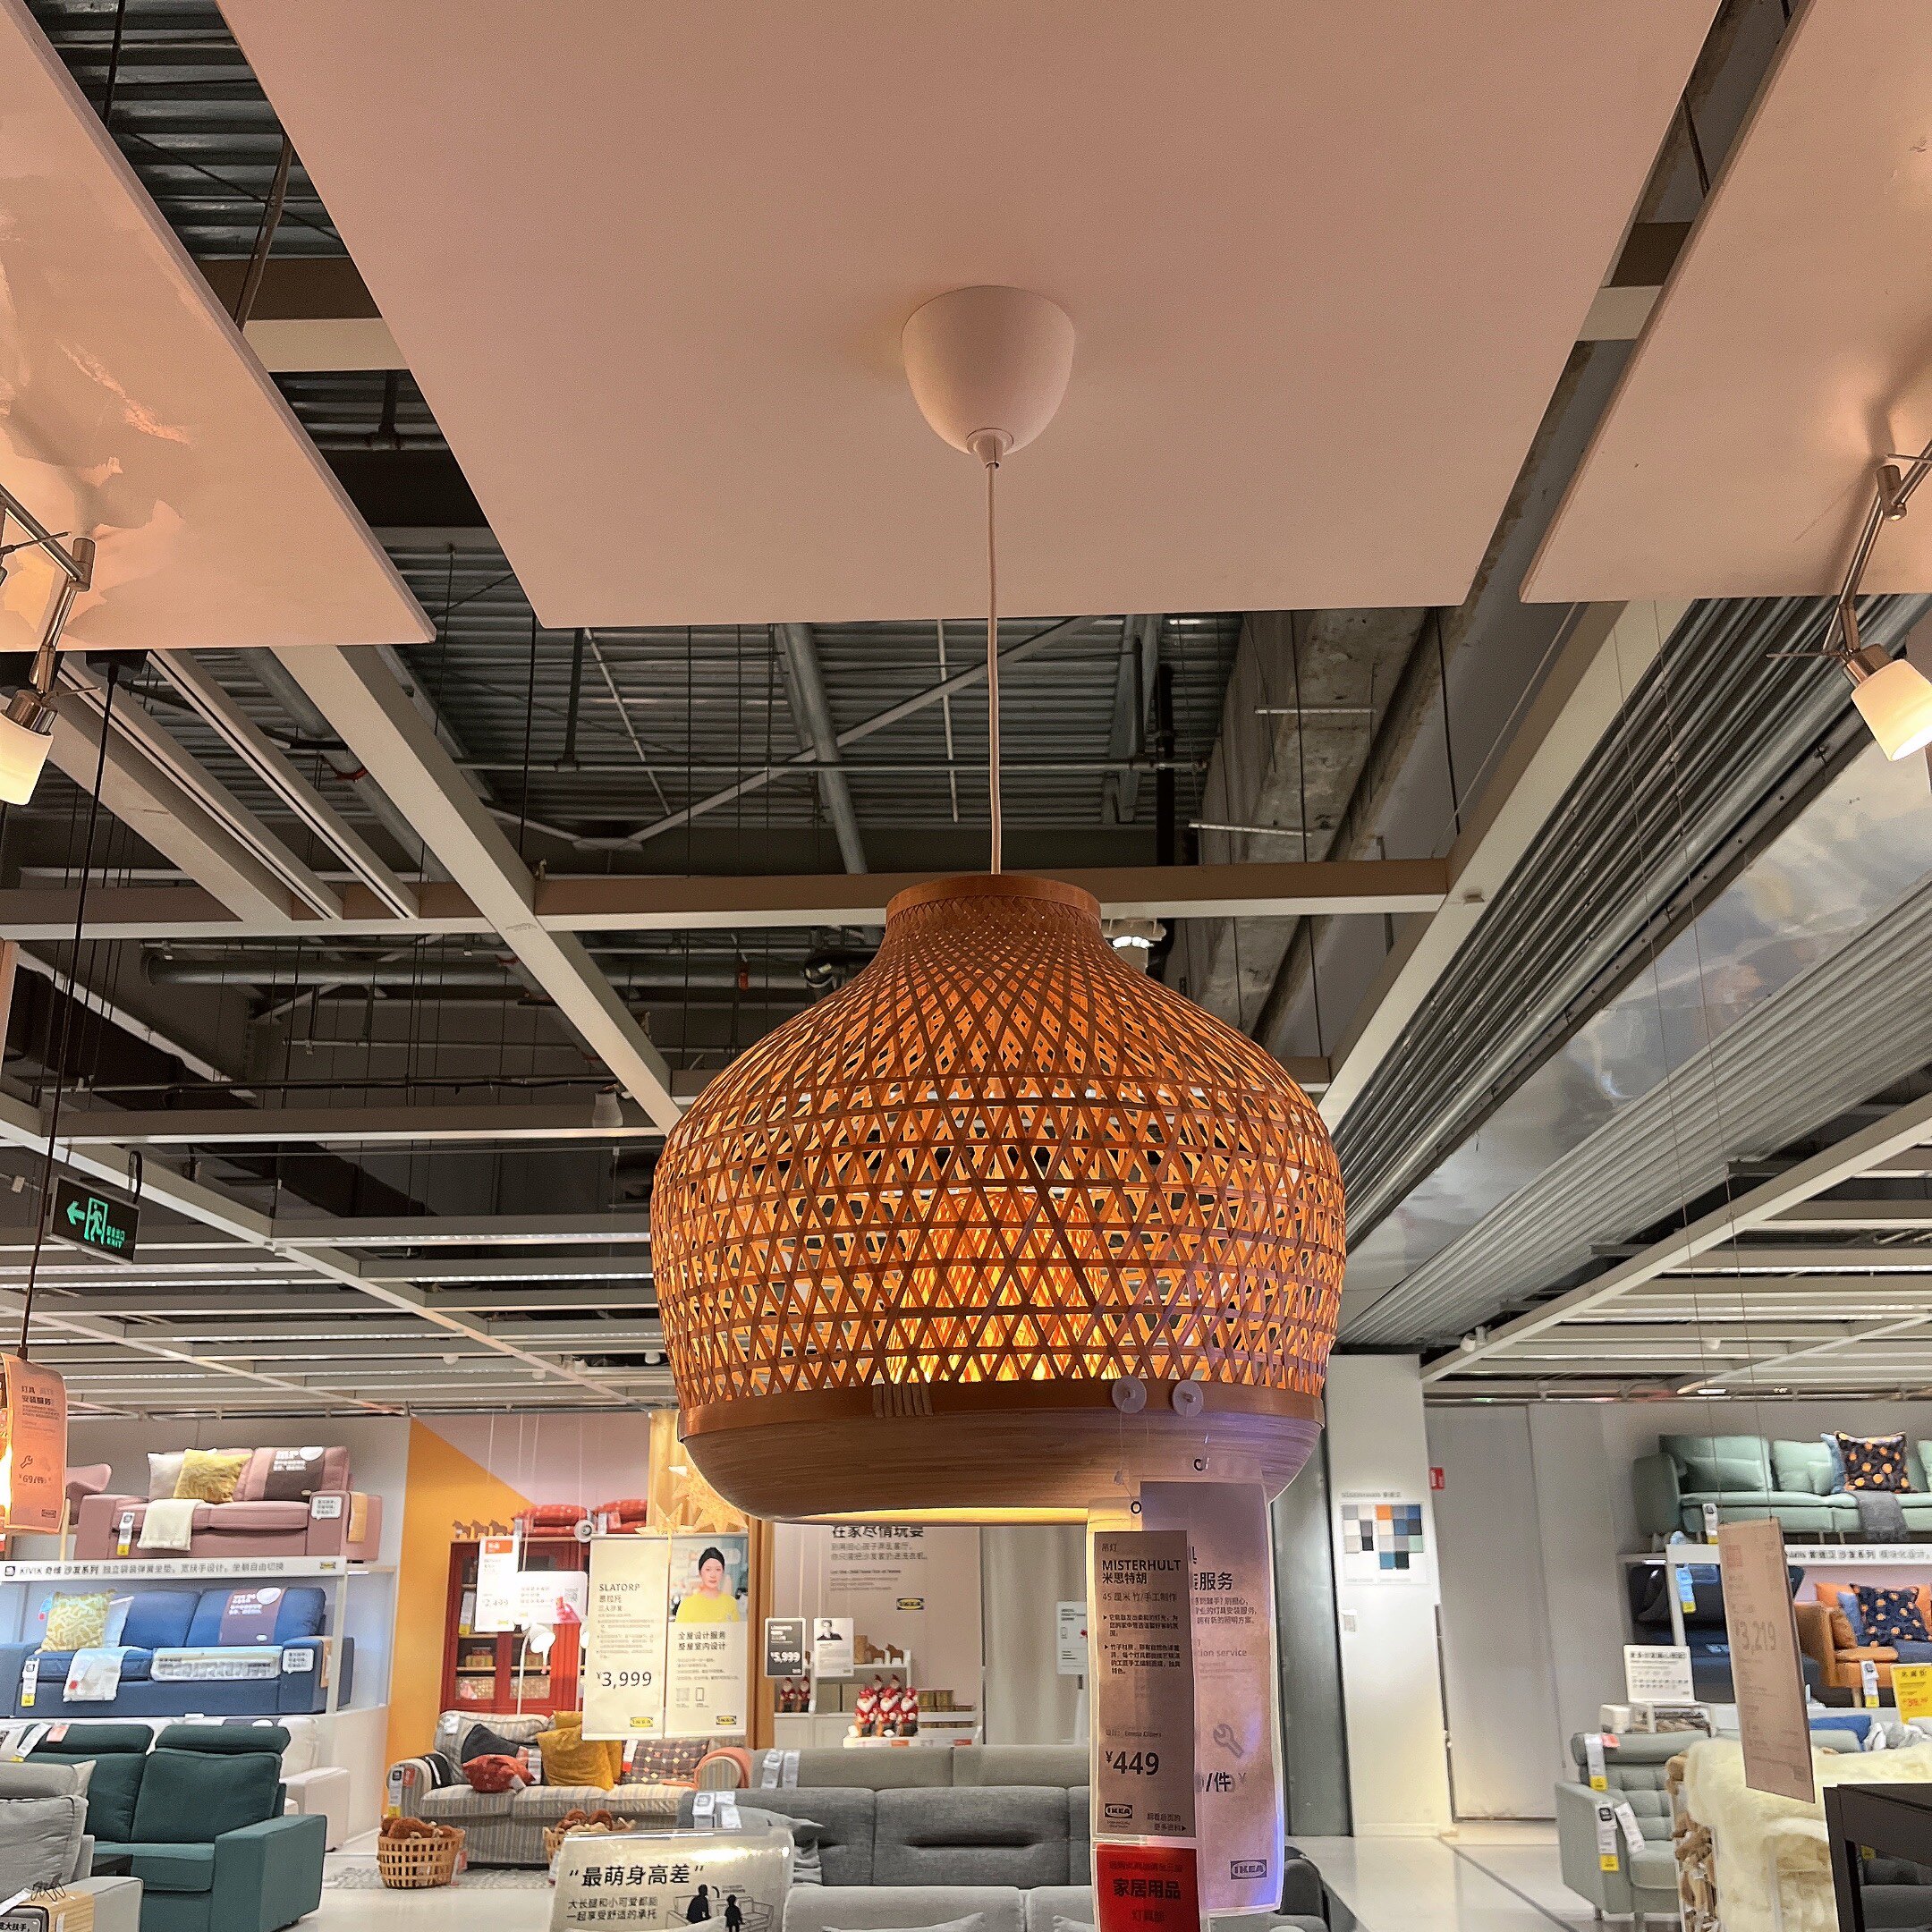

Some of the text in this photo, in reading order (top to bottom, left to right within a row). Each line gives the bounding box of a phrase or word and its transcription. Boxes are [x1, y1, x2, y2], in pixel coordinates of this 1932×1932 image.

[1101, 1543, 1117, 1553] 吊灯
[1101, 1559, 1182, 1572] MISTERHULT
[1102, 1572, 1148, 1585] 米思特胡
[598, 1583, 640, 1592] SLATORP
[1102, 1592, 1112, 1601] 45
[1114, 1592, 1131, 1602] 厘米
[1216, 1648, 1248, 1657] service
[596, 1670, 653, 1690] ¥3,999
[1105, 1750, 1160, 1776] ¥449
[1112, 1877, 1182, 1900] 家居用品
